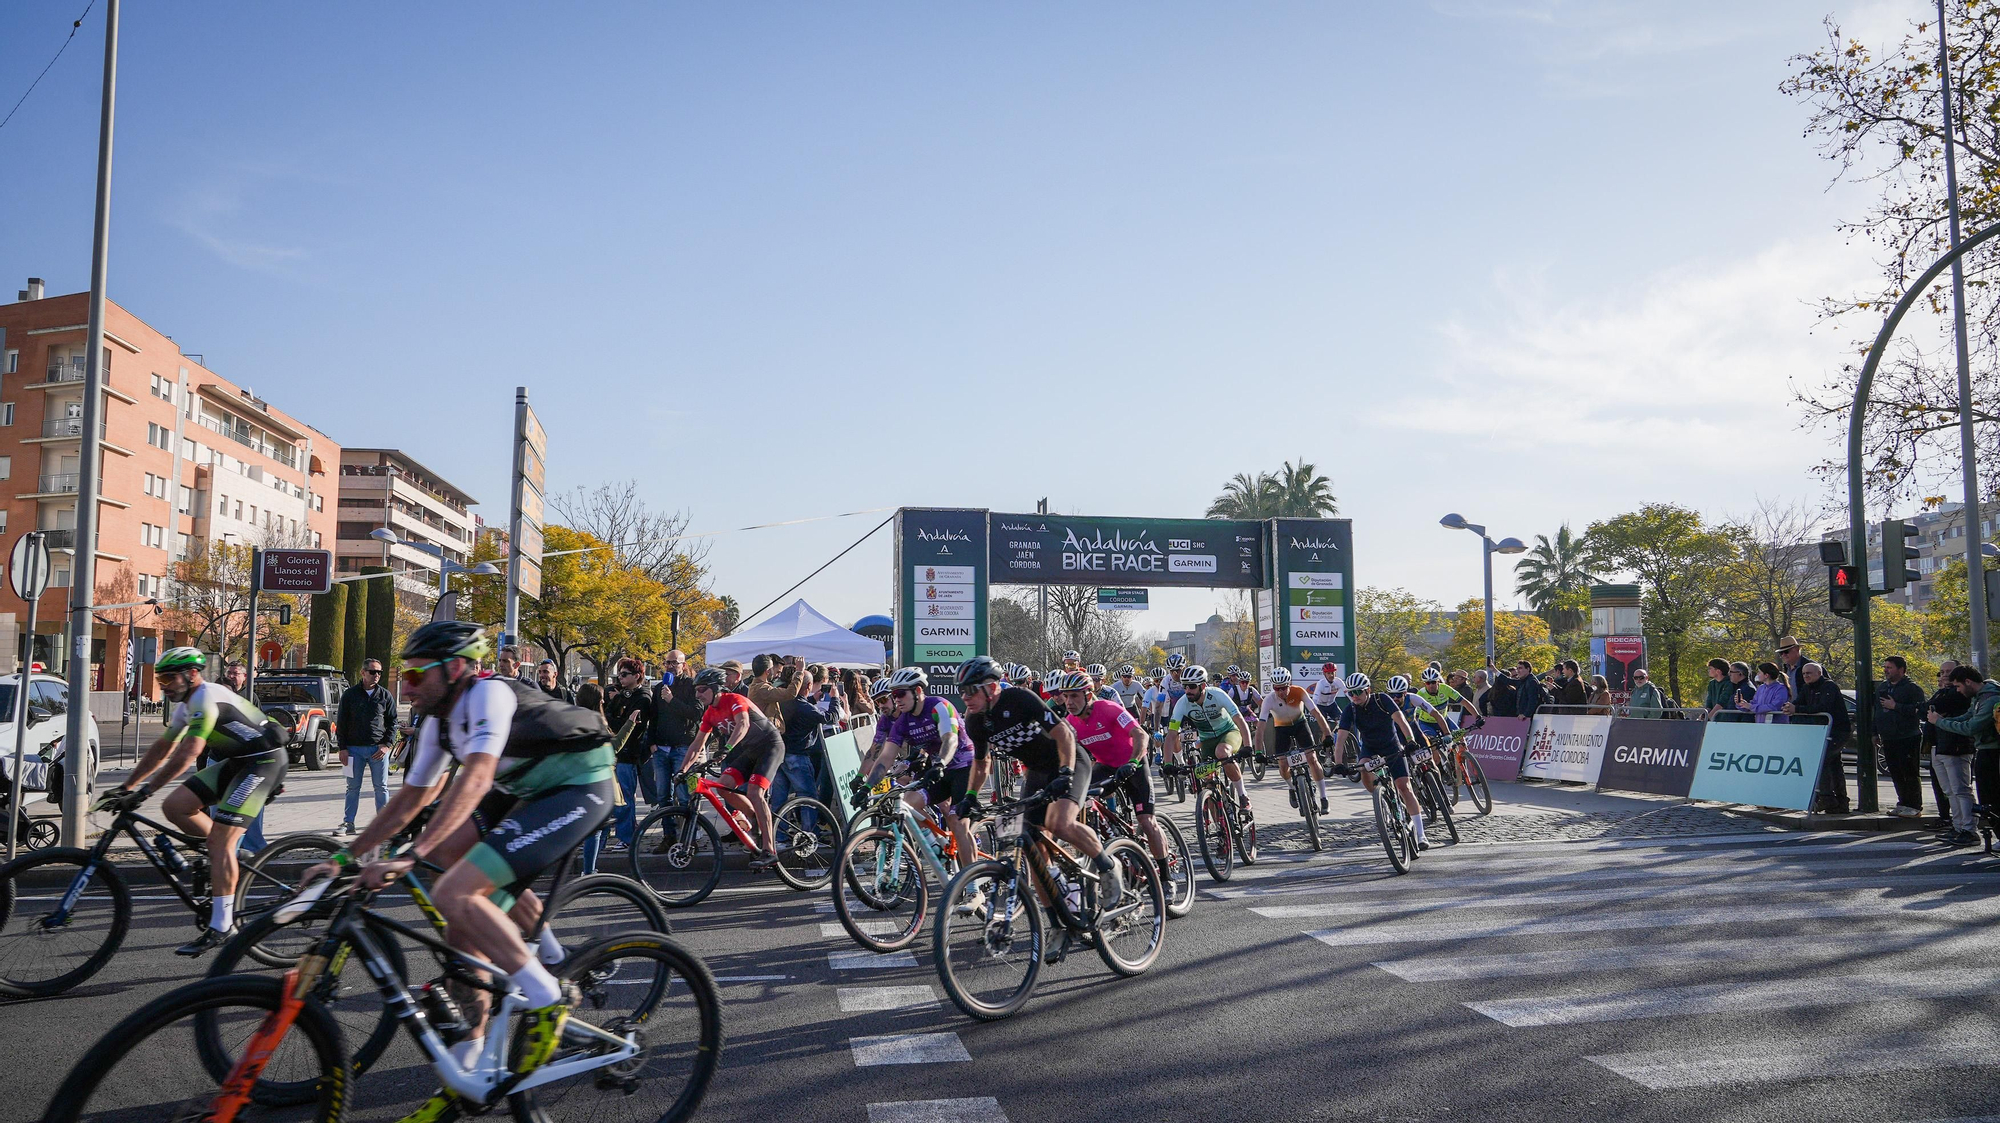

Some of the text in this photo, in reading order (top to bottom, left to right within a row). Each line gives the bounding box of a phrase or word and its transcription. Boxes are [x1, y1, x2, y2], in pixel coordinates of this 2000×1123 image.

[917, 528, 972, 542] Andalucía
[1009, 541, 1041, 549] GRANADA
[1061, 527, 1163, 554] Andalucía
[1172, 541, 1189, 549] UCI
[1290, 537, 1339, 550] Andalucía
[1016, 550, 1034, 559] JAÉN
[287, 556, 320, 565] Glorieta
[1009, 560, 1041, 569] CÓRDOBA
[1062, 552, 1164, 572] BIKE RACE
[274, 567, 318, 576] Llanos del
[279, 577, 313, 586] Pretorio
[921, 628, 970, 636] GARMIN
[1296, 631, 1340, 639] GARMIN
[930, 685, 960, 695] GOBIK
[1183, 732, 1194, 740] 822
[1555, 733, 1603, 747] AYUNTAMIENTO
[1473, 734, 1521, 753] IMDECO
[1291, 754, 1302, 764] 890
[1551, 750, 1559, 762] DE
[1614, 745, 1689, 768] GARMIN
